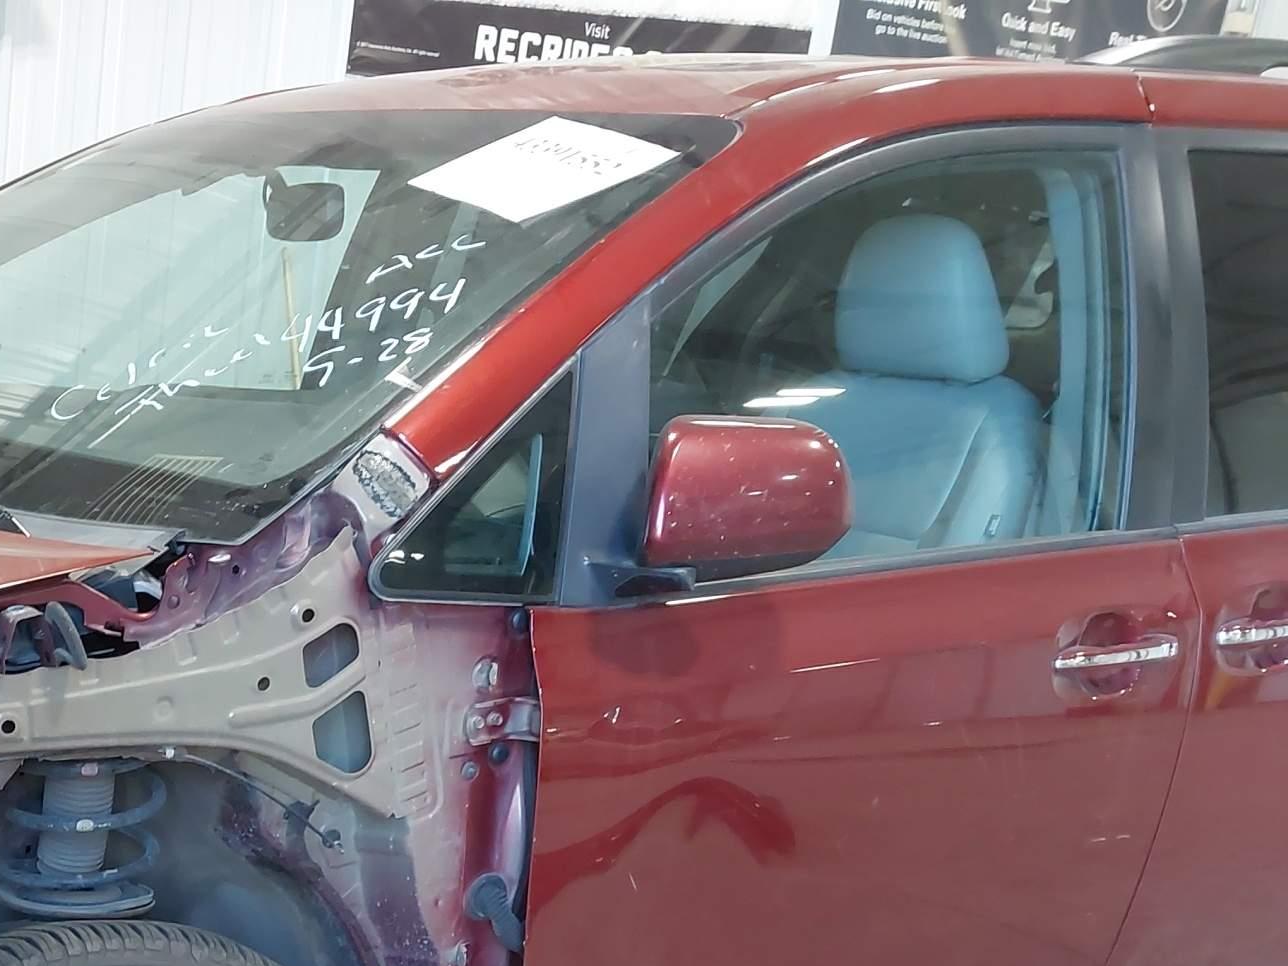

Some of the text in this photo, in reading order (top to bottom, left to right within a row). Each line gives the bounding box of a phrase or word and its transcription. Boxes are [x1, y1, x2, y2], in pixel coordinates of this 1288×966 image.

[866, 8, 882, 20] Bid
[881, 13, 893, 22] on
[585, 22, 611, 39] Visit
[875, 24, 887, 35] go
[887, 25, 896, 35] to
[896, 27, 908, 37] the
[1001, 12, 1076, 42] Quick and Easy
